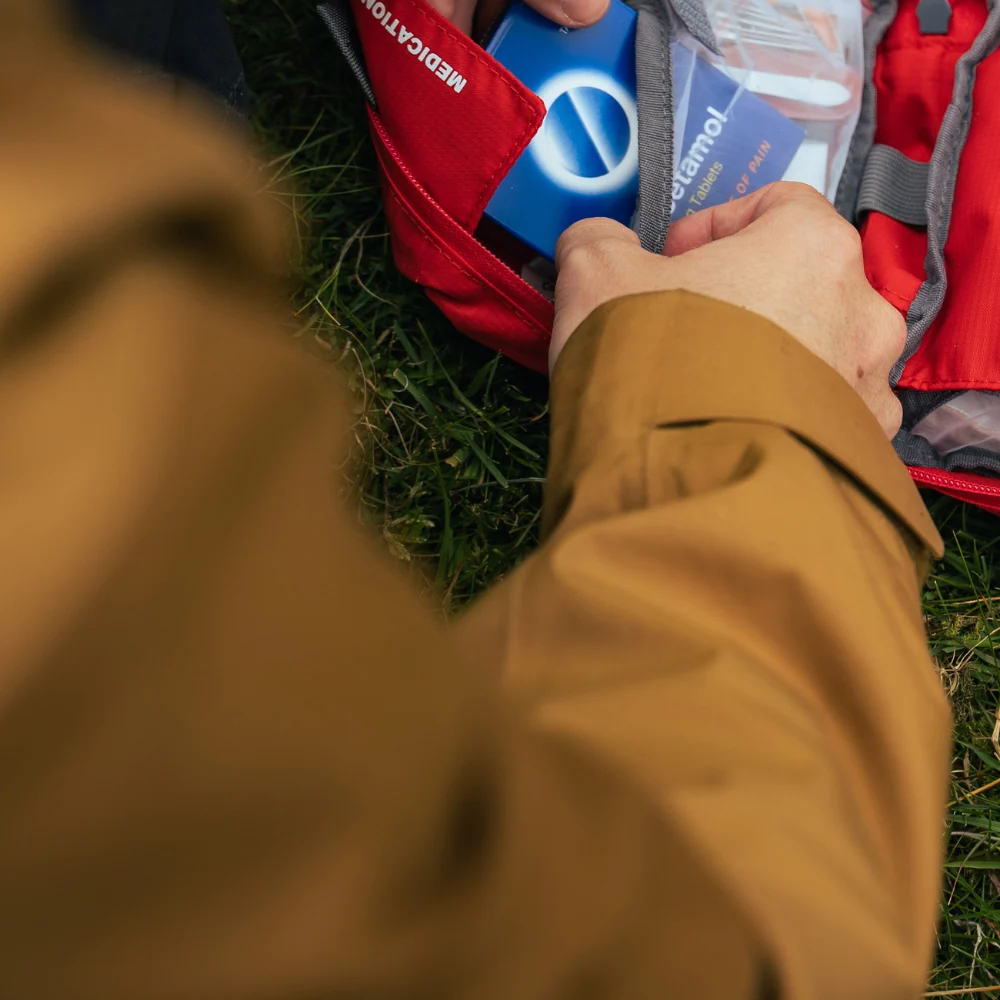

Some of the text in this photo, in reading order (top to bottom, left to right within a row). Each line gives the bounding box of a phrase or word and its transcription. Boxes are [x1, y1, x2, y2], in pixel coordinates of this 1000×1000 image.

[689, 161, 724, 206] Tablets
[736, 140, 771, 194] OF PAIN
